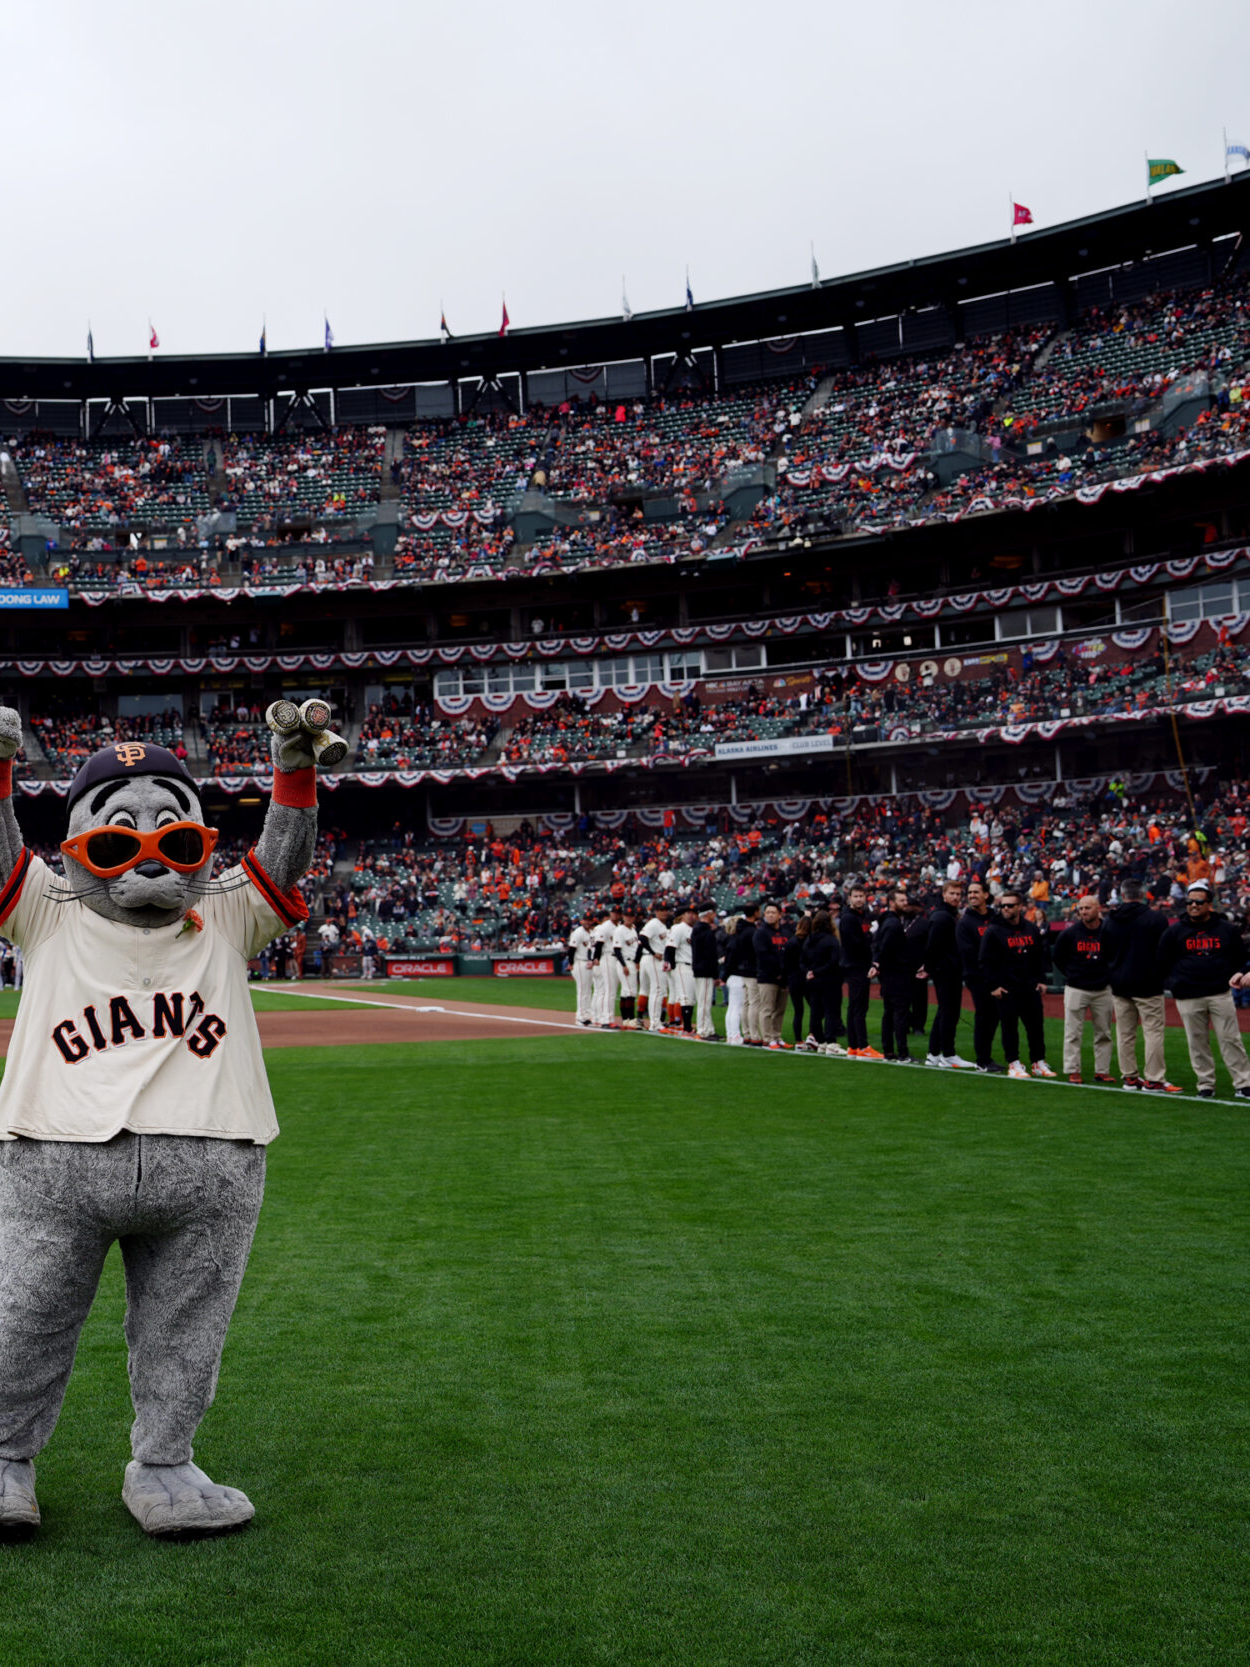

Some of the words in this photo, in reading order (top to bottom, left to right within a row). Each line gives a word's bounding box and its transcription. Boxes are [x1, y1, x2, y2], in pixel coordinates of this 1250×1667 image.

[33, 595, 60, 604] LAW
[745, 744, 778, 753] AIRLINES
[811, 739, 833, 747] LEVEL
[114, 741, 147, 767] SF
[1007, 936, 1034, 948] GIANTS
[1077, 941, 1100, 952] GIANT
[1186, 938, 1221, 950] GIANTS
[392, 963, 447, 974] ORACLE
[497, 962, 548, 973] ORACLE
